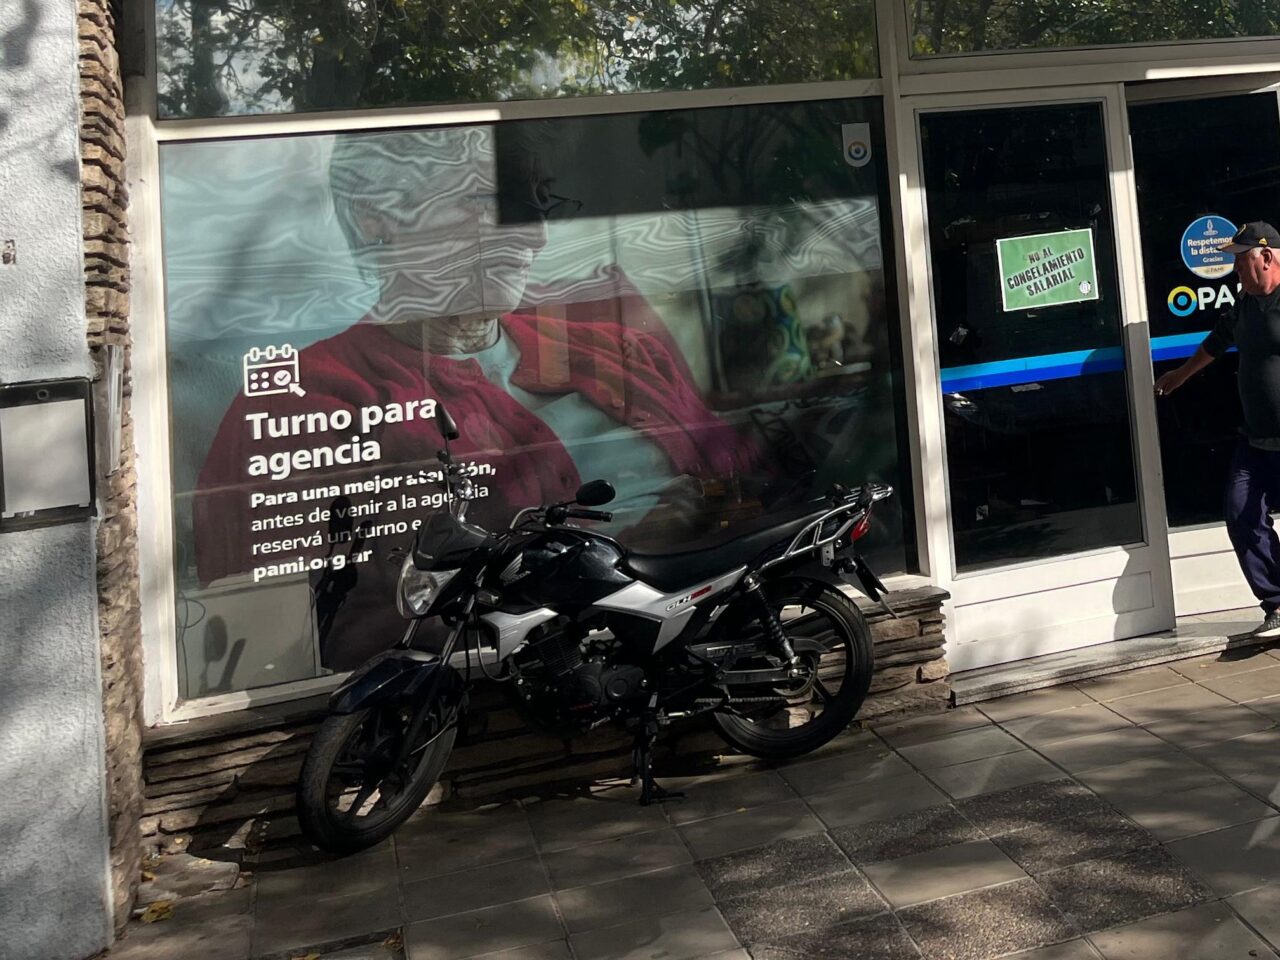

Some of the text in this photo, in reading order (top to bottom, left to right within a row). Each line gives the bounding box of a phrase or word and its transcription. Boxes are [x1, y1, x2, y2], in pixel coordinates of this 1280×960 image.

[1007, 247, 1085, 290] CONGELAMIENTO
[1028, 246, 1053, 264] NO AL
[1191, 247, 1198, 256] la
[1026, 267, 1075, 297] SALARIAL
[246, 398, 437, 441] Turno para
[248, 436, 381, 480] agencia
[251, 491, 298, 508] Para
[302, 485, 340, 500] una
[344, 475, 403, 494] mejor
[251, 513, 303, 531] antes
[308, 507, 331, 523] de
[335, 500, 383, 518] venir
[386, 500, 397, 512] a
[401, 494, 417, 510] la
[252, 530, 322, 555] reservá
[327, 530, 351, 544] un
[355, 520, 408, 539] turno
[253, 549, 373, 583] pami.org.ar
